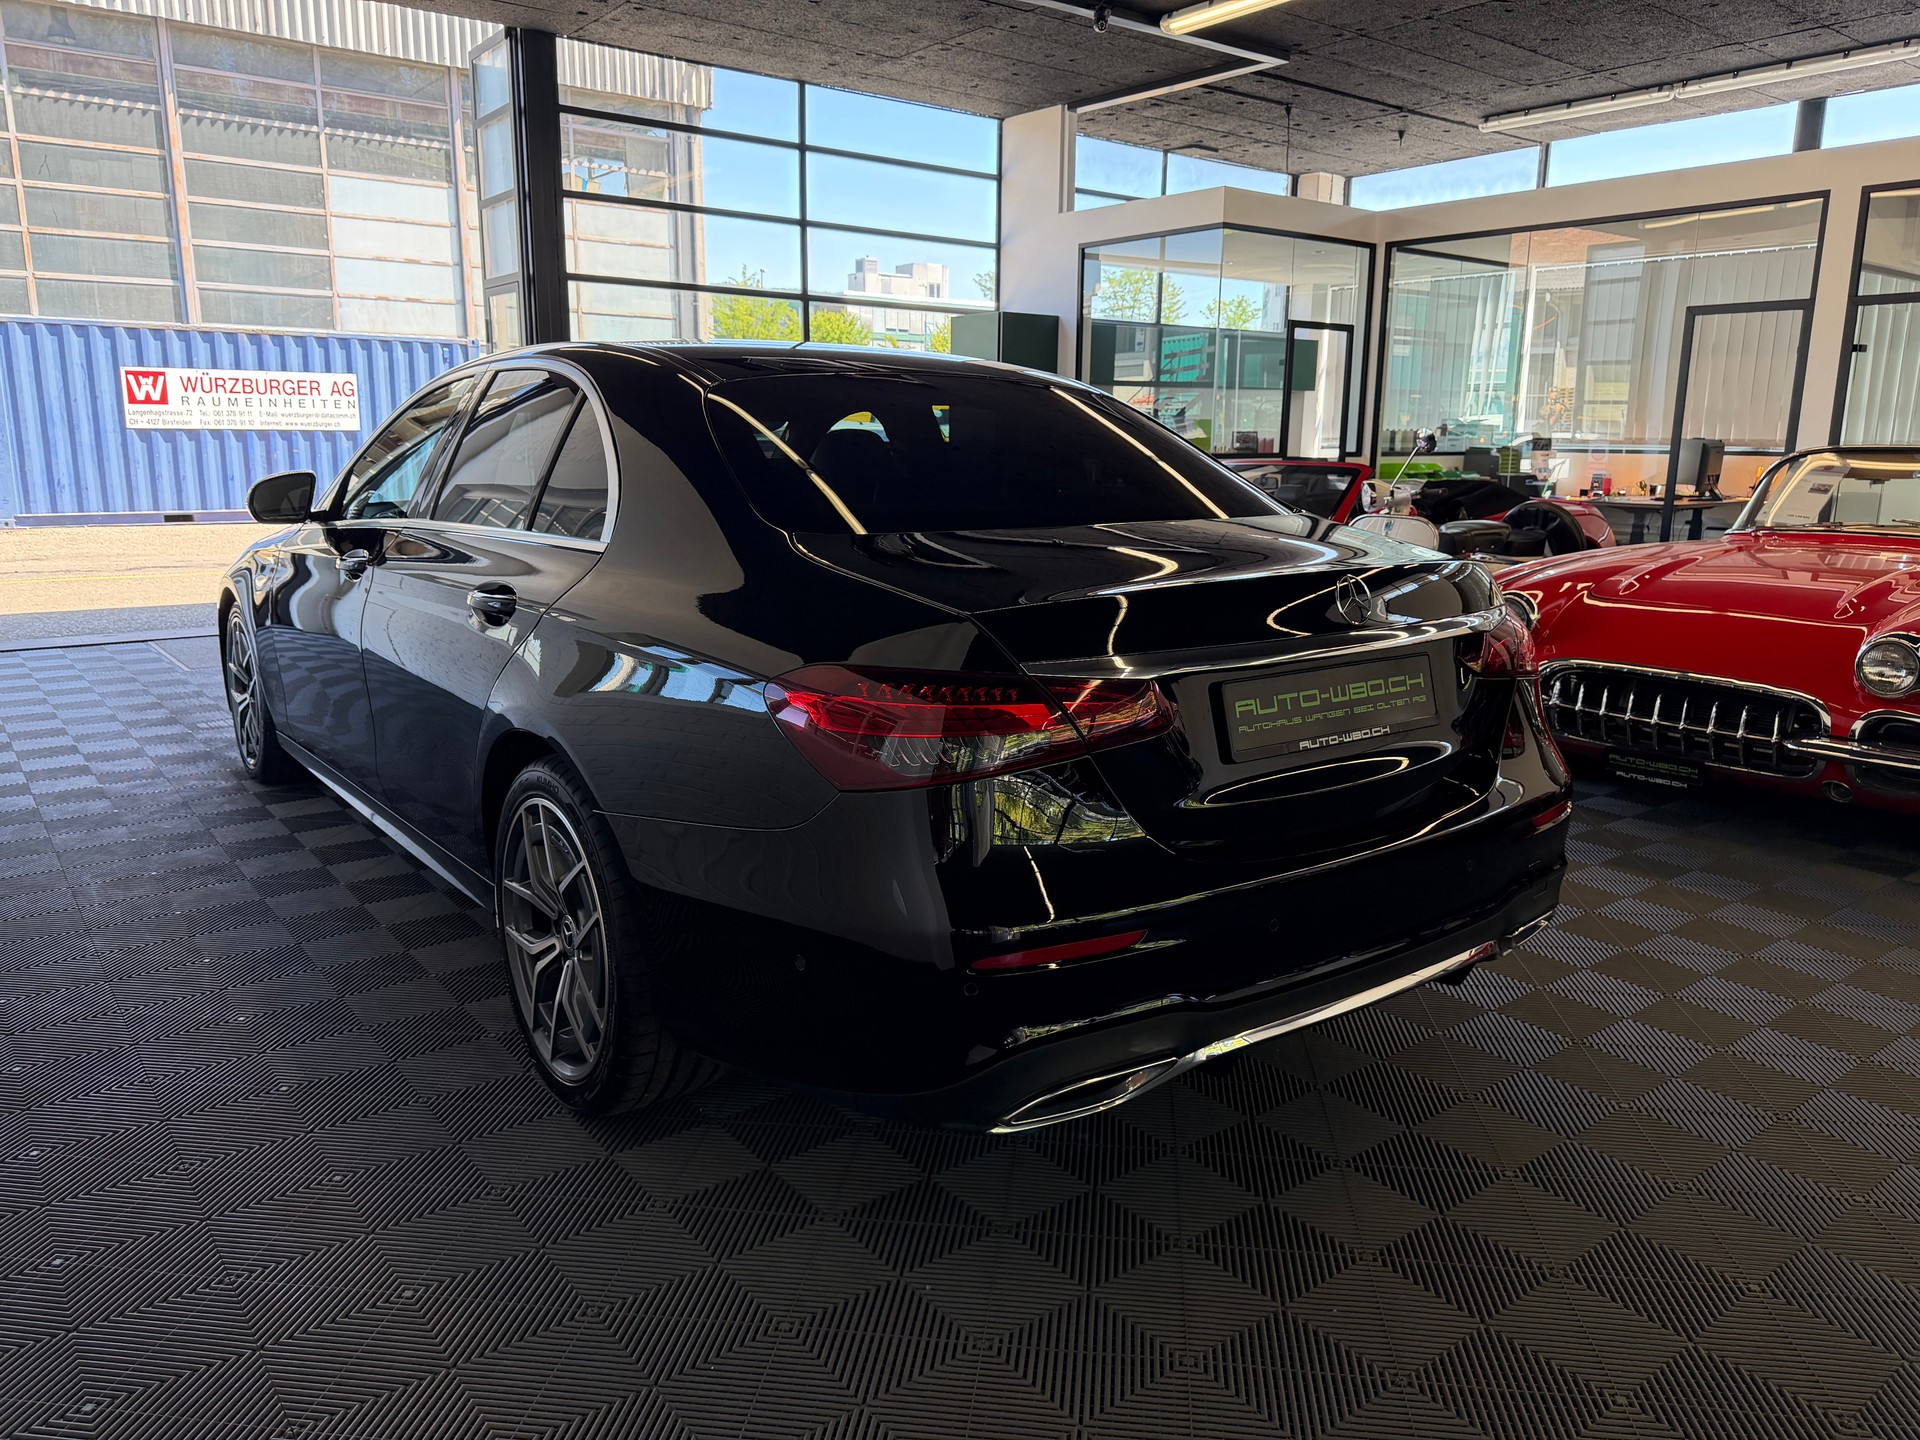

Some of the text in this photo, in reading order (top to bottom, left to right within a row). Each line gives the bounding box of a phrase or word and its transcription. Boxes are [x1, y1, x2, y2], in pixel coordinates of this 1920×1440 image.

[179, 372, 355, 397] WÜRZBURGER AG
[181, 395, 356, 409] RAUMEINHEITEN
[1238, 716, 1302, 733] AUTOHAUS
[1305, 708, 1351, 722] WANGEN
[1353, 704, 1375, 714] BEI
[1377, 697, 1411, 710] OLTEN
